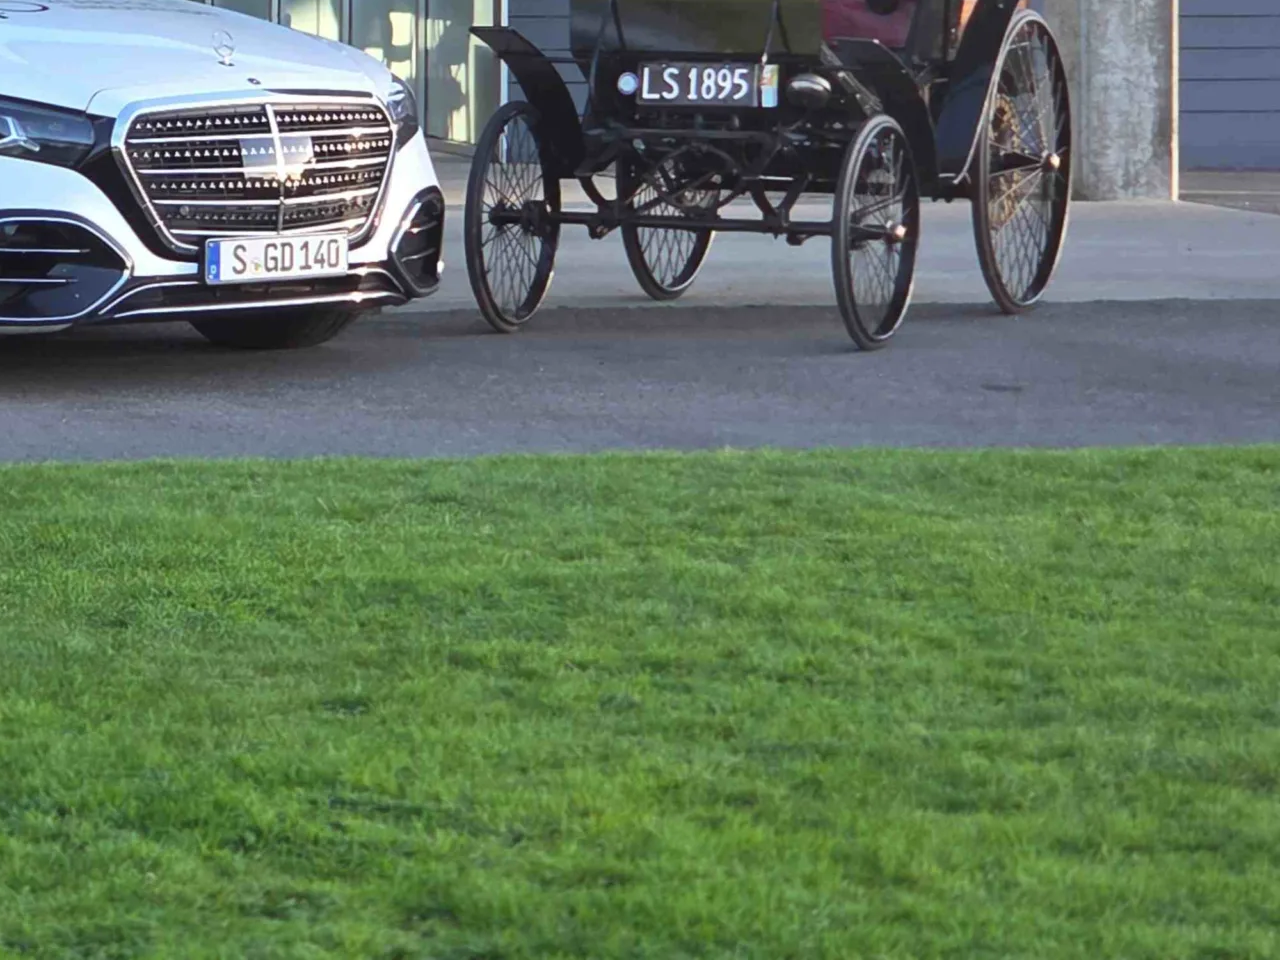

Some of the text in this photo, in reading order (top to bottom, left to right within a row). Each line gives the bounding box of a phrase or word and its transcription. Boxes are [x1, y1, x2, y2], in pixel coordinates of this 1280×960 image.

[642, 67, 749, 100] LS 1895
[232, 244, 247, 275] S
[300, 239, 339, 270] 140
